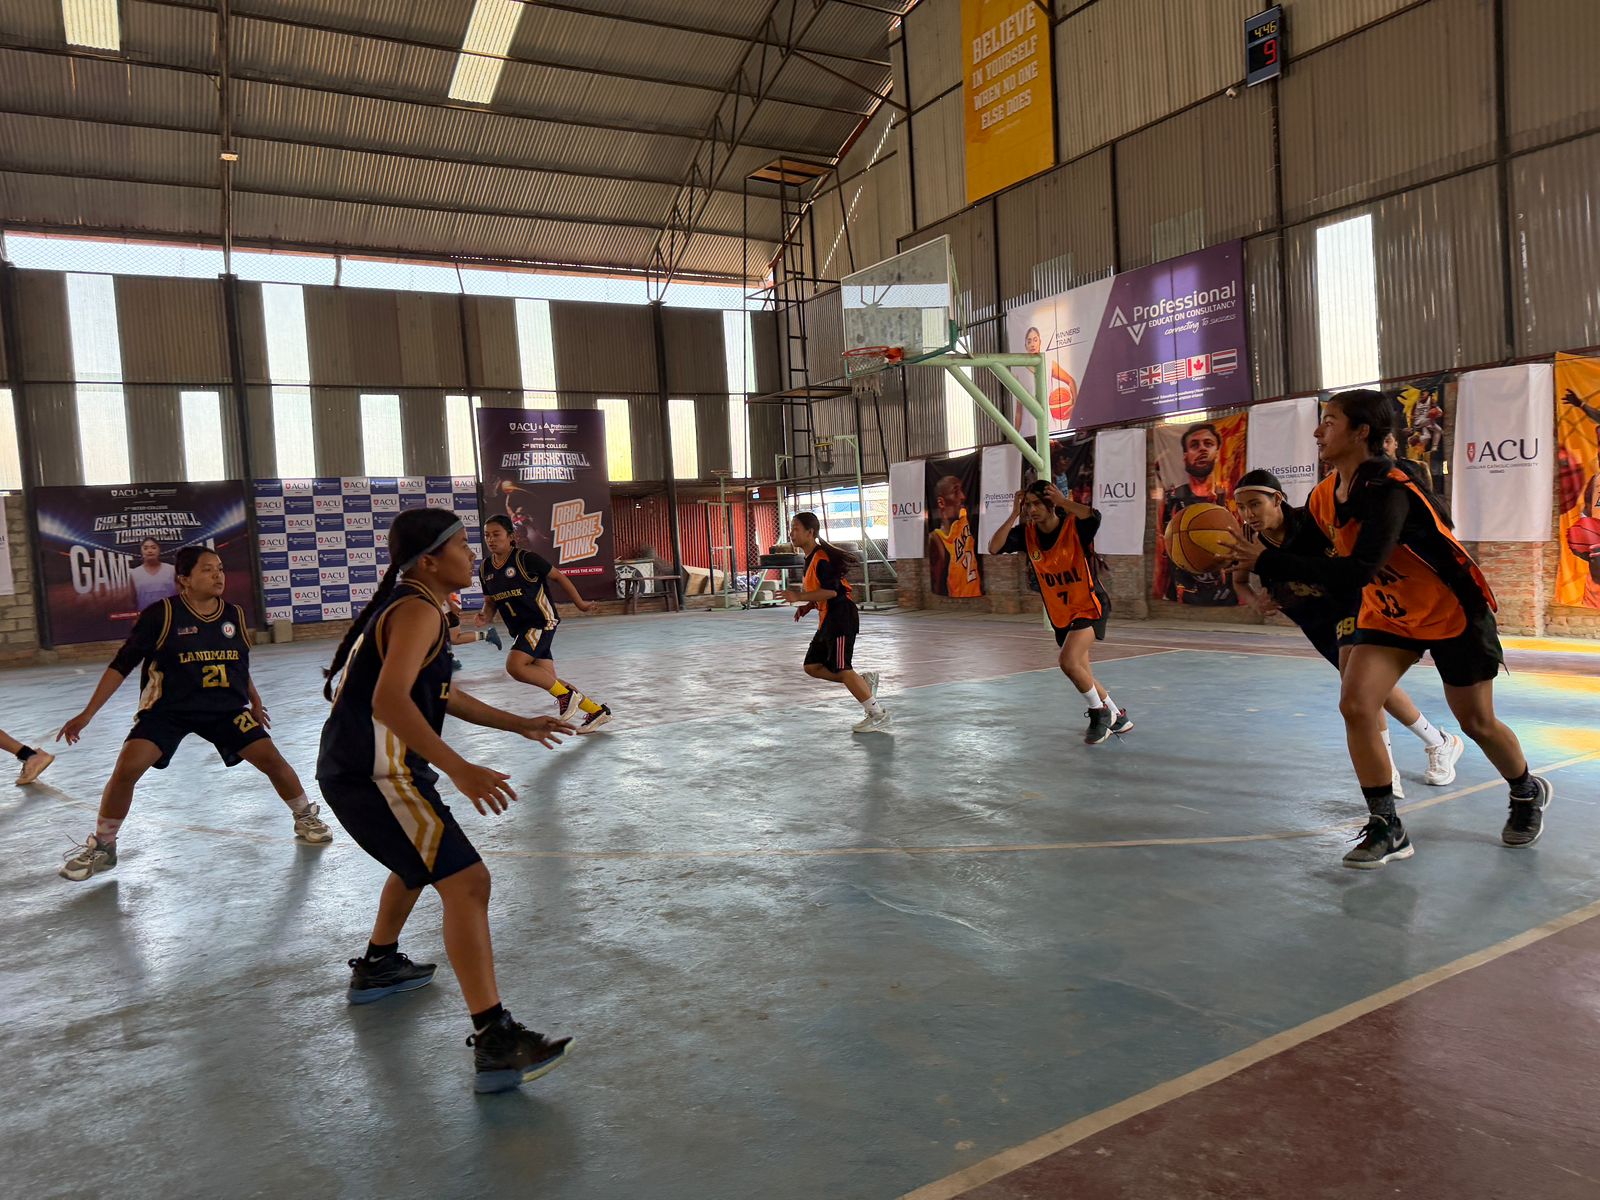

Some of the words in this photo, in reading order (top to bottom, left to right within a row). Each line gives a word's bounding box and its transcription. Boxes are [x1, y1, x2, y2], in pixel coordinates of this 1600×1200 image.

[973, 1, 1036, 65] BELIEVE
[1264, 39, 1277, 65] 9
[972, 68, 983, 89] IN
[985, 34, 1038, 81] YOURSELF
[974, 82, 1001, 111] WHEN
[1003, 74, 1016, 94] NO
[1019, 61, 1038, 85] ONE
[981, 104, 1005, 130] ELSE
[1006, 88, 1032, 116] DOES
[1133, 280, 1236, 322] Professional
[1186, 299, 1236, 318] CONSULTANCY
[1164, 320, 1200, 336] connecting
[517, 423, 537, 431] ACU
[1478, 437, 1539, 463] ACU
[501, 453, 530, 468] GIRLS
[531, 451, 591, 467] BASKETBALL
[519, 467, 575, 481] TOURNAMENT
[291, 482, 310, 490] ACU
[350, 481, 368, 489] ACU
[405, 480, 423, 488] ACU
[1103, 482, 1136, 498] ACU
[323, 500, 340, 508] ACU
[985, 493, 1014, 501] Profession
[899, 502, 922, 515] ACU
[94, 514, 129, 532] GIRLS
[131, 512, 202, 528] BASKETBALL
[294, 519, 313, 527] ACU
[115, 527, 184, 545] TOURNAMENT
[1040, 567, 1082, 587] OYAL
[1057, 591, 1069, 606] 7
[504, 601, 517, 617] 1
[202, 664, 230, 688] 21
[233, 710, 260, 734] 21
